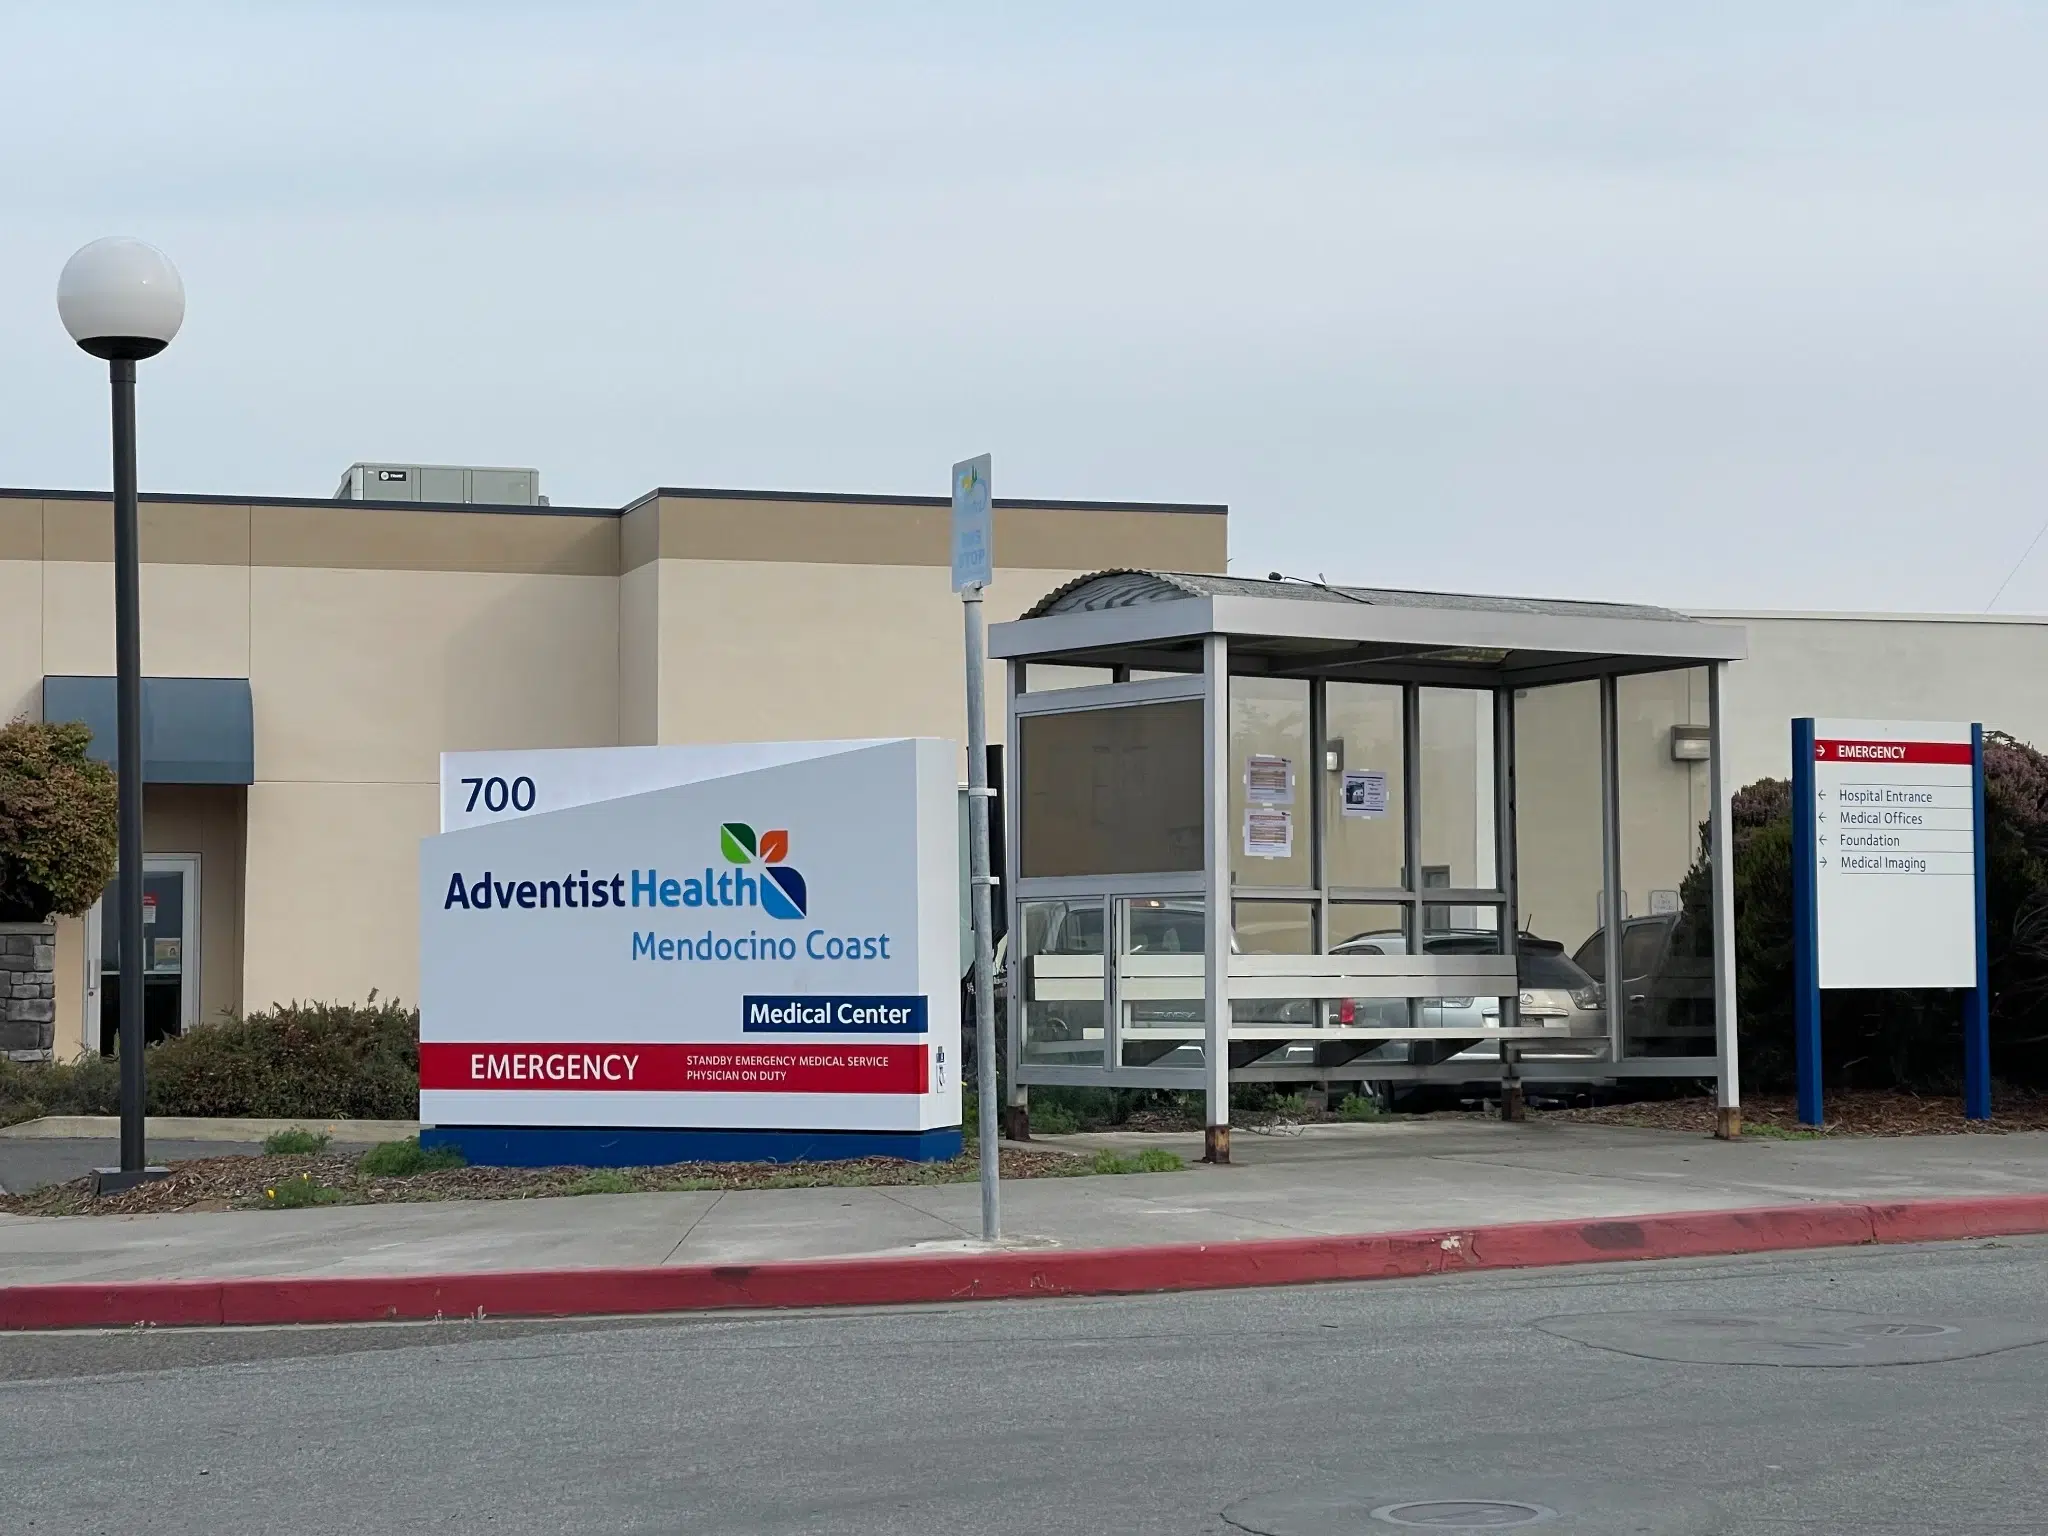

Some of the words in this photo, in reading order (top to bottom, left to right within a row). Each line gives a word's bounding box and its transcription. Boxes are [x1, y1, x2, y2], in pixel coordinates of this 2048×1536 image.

[1838, 744, 1906, 759] EMERGENCY
[460, 776, 536, 812] 700
[1839, 789, 1883, 805] Hospital
[1886, 790, 1933, 803] Entrance
[1840, 811, 1881, 824] Medical
[1884, 811, 1923, 825] Offices
[1840, 834, 1900, 847] Foundation
[1841, 856, 1882, 869] Medical
[1885, 857, 1926, 872] Imaging
[632, 930, 797, 961] Mendocino
[806, 930, 891, 960] Coast
[750, 1003, 831, 1024] Medical
[837, 1004, 912, 1024] Center
[471, 1053, 639, 1081] EMERGENCY
[686, 1055, 733, 1066] STANDBY
[735, 1055, 797, 1067] EMERGENCY
[799, 1056, 846, 1067] MEDICAL
[847, 1056, 889, 1067] SERVICE
[686, 1070, 740, 1081] PHYSICIAN
[741, 1070, 757, 1081] ON
[759, 1070, 787, 1082] DUTY
